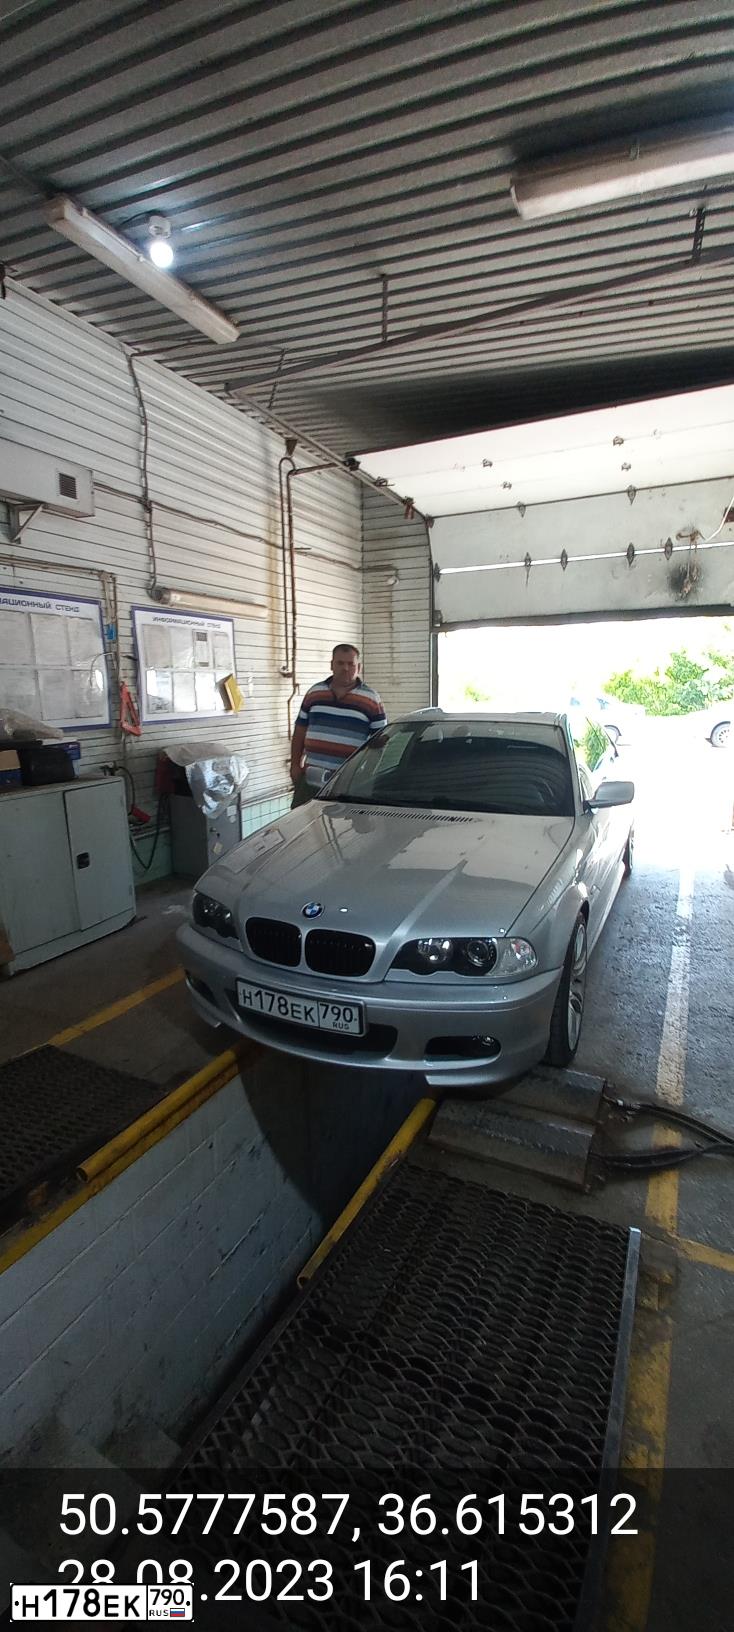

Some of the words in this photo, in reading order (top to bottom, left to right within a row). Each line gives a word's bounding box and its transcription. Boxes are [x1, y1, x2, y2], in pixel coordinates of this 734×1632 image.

[0, 597, 52, 609] АЦИОННЫЙ
[55, 604, 80, 612] СТЕНД
[242, 989, 316, 1023] Н178ЕК
[319, 1003, 354, 1023] 790
[332, 1022, 350, 1030] RUS
